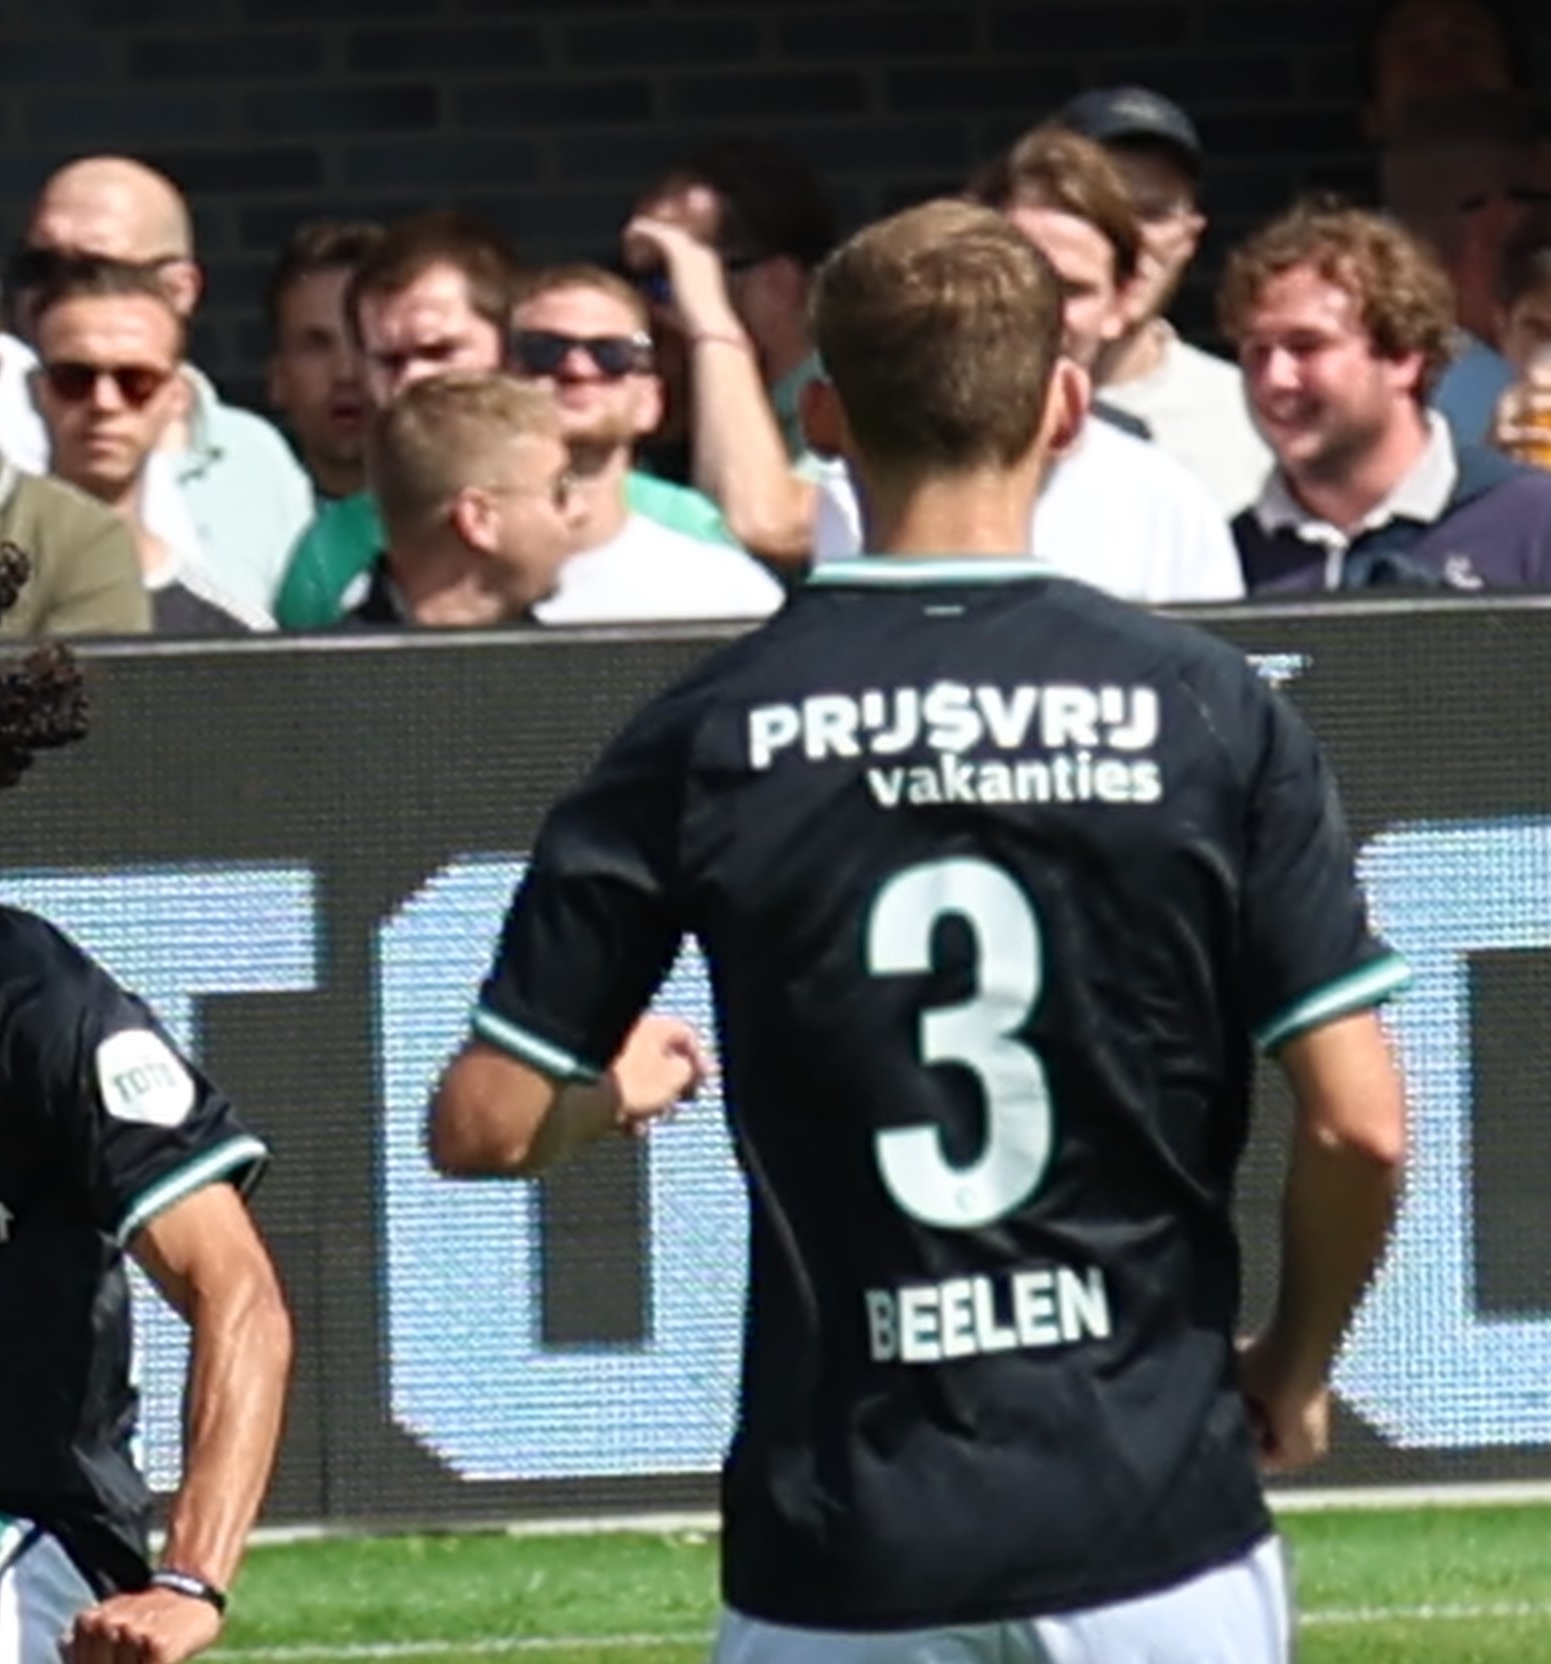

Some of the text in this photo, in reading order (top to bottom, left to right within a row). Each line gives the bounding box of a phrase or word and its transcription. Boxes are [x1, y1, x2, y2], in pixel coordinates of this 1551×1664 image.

[869, 752, 1162, 808] vakanties
[868, 857, 1052, 1228] 3
[866, 1266, 1112, 1362] BEELEN
